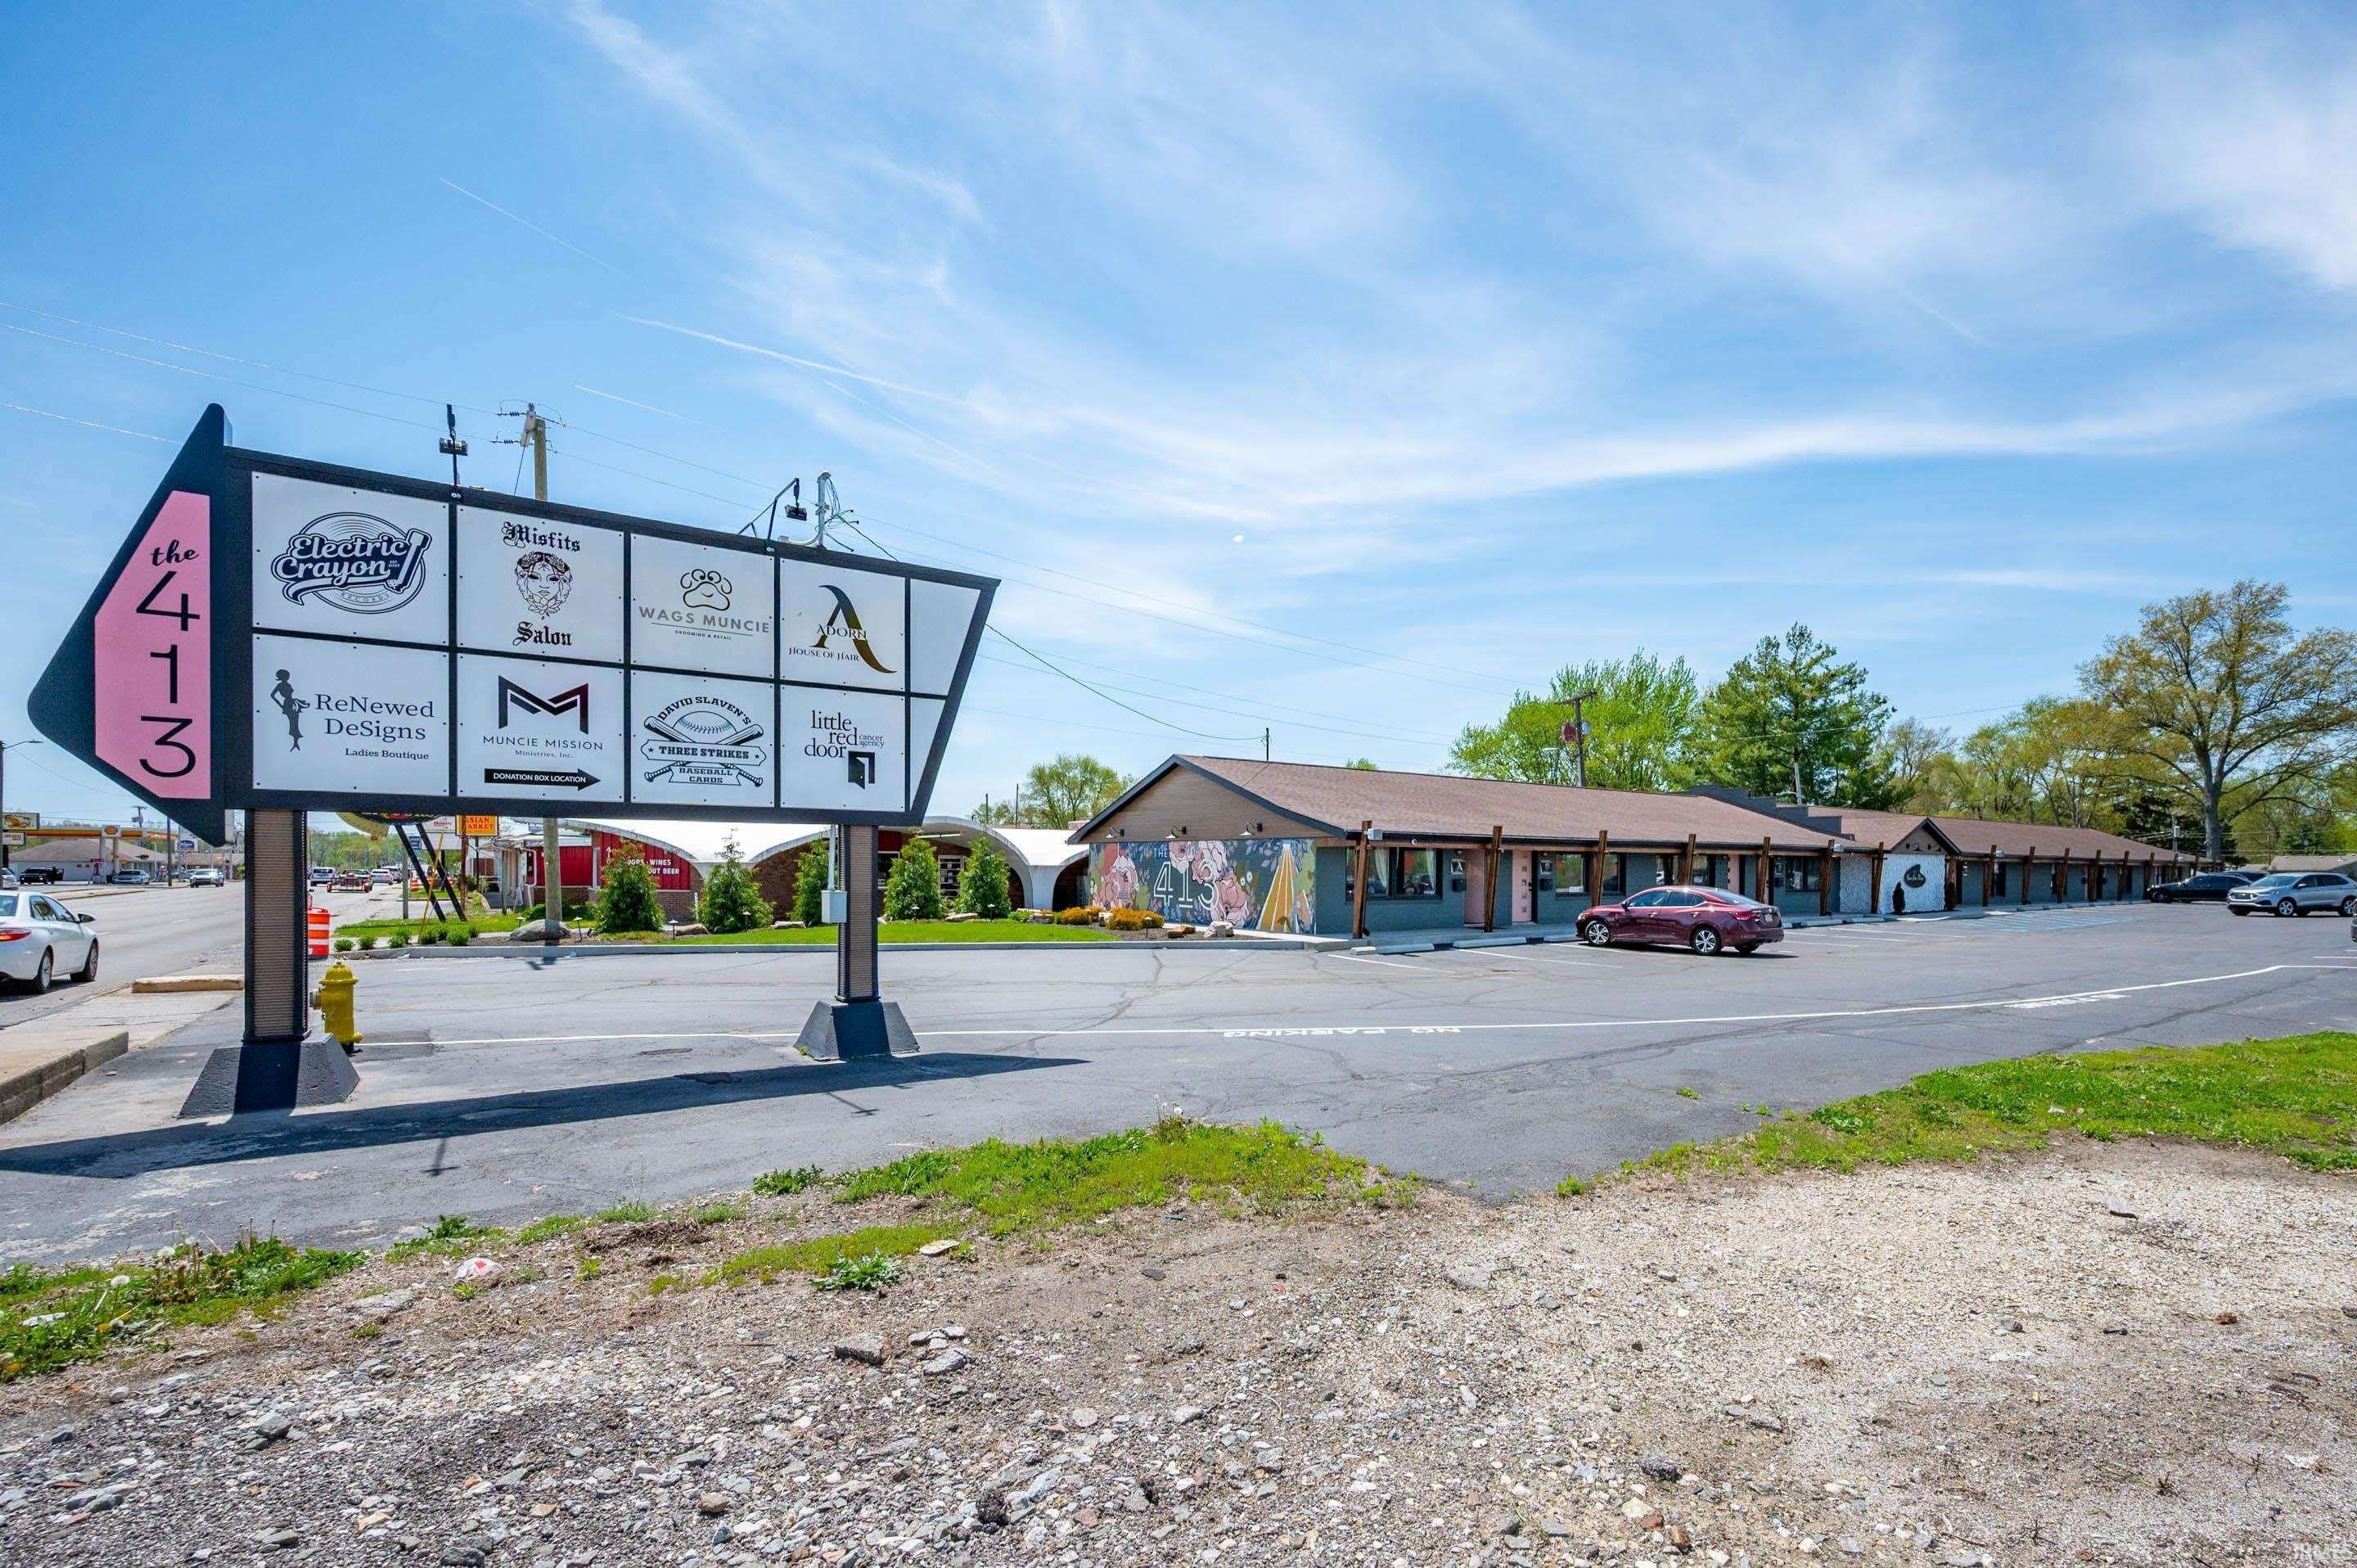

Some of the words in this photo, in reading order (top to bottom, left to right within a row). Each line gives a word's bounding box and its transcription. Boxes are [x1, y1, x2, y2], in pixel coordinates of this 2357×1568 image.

[290, 534, 408, 559] Electric
[501, 521, 581, 552] Misfits
[151, 539, 200, 566] the
[276, 556, 390, 586] Crayon
[638, 606, 695, 624] WAGS
[702, 615, 769, 633] MUNCIE
[512, 621, 573, 647] Salon
[817, 624, 868, 640] ADORN
[789, 647, 821, 657] HOUSE
[822, 651, 834, 659] OF
[837, 652, 860, 661] HAIR
[314, 693, 435, 718] ReNewed
[657, 697, 693, 721] DAVID
[695, 696, 751, 725] SLAVEN'S
[324, 718, 426, 743] DeSigns
[811, 710, 852, 731] little
[483, 736, 539, 747] MUNCIE
[545, 740, 603, 750] MISSION
[828, 727, 858, 746] red
[859, 733, 884, 741] cancer
[859, 739, 885, 749] agency
[345, 748, 379, 757] Ladies
[381, 750, 430, 760] Boutique
[658, 746, 698, 756] THREE
[701, 748, 750, 759] STRIKES
[804, 737, 847, 758] door
[493, 773, 533, 781] DONATION
[551, 775, 586, 783] LOCATION
[679, 767, 733, 776] BASEBALL
[1153, 848, 1169, 858] THE
[1153, 858, 1219, 911] 413
